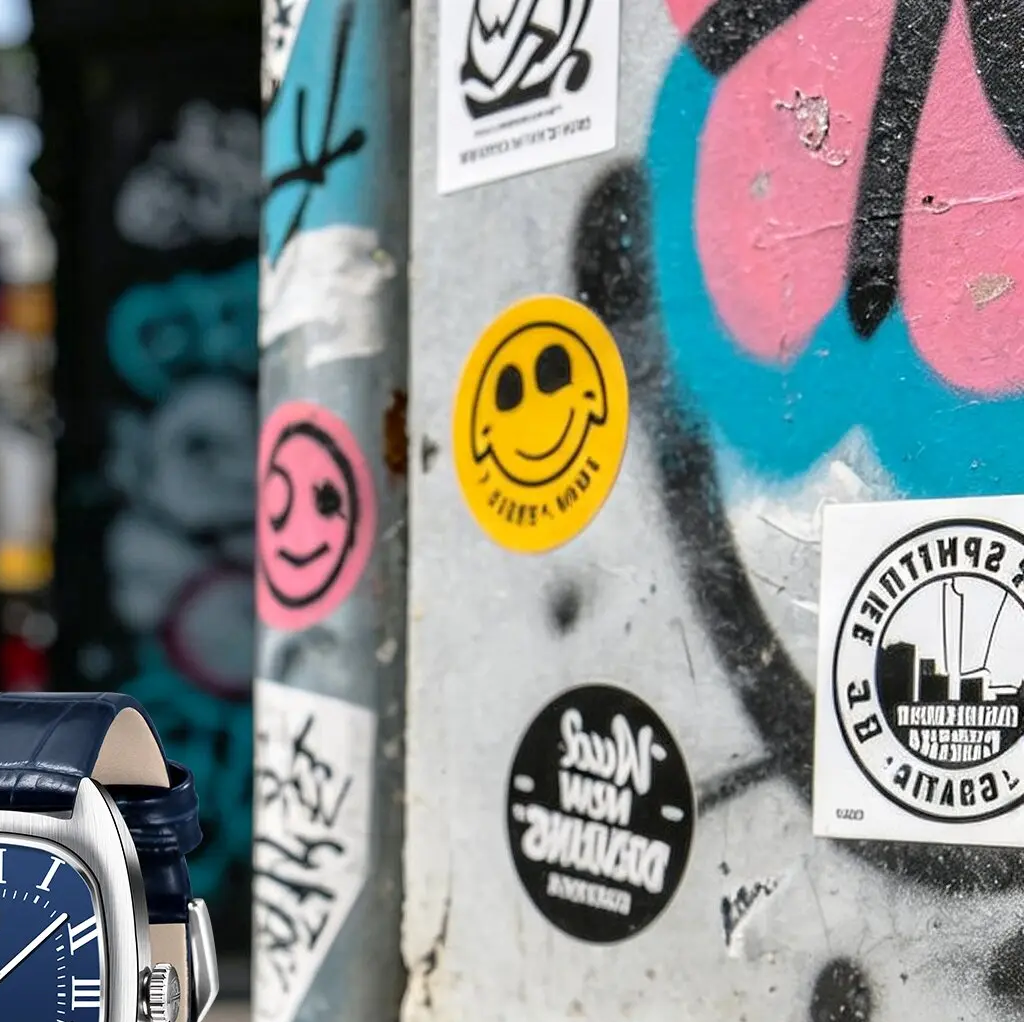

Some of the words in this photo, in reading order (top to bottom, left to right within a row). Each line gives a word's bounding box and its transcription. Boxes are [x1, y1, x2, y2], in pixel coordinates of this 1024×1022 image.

[35, 856, 66, 892] I
[67, 915, 98, 956] II
[71, 975, 101, 1011] III
